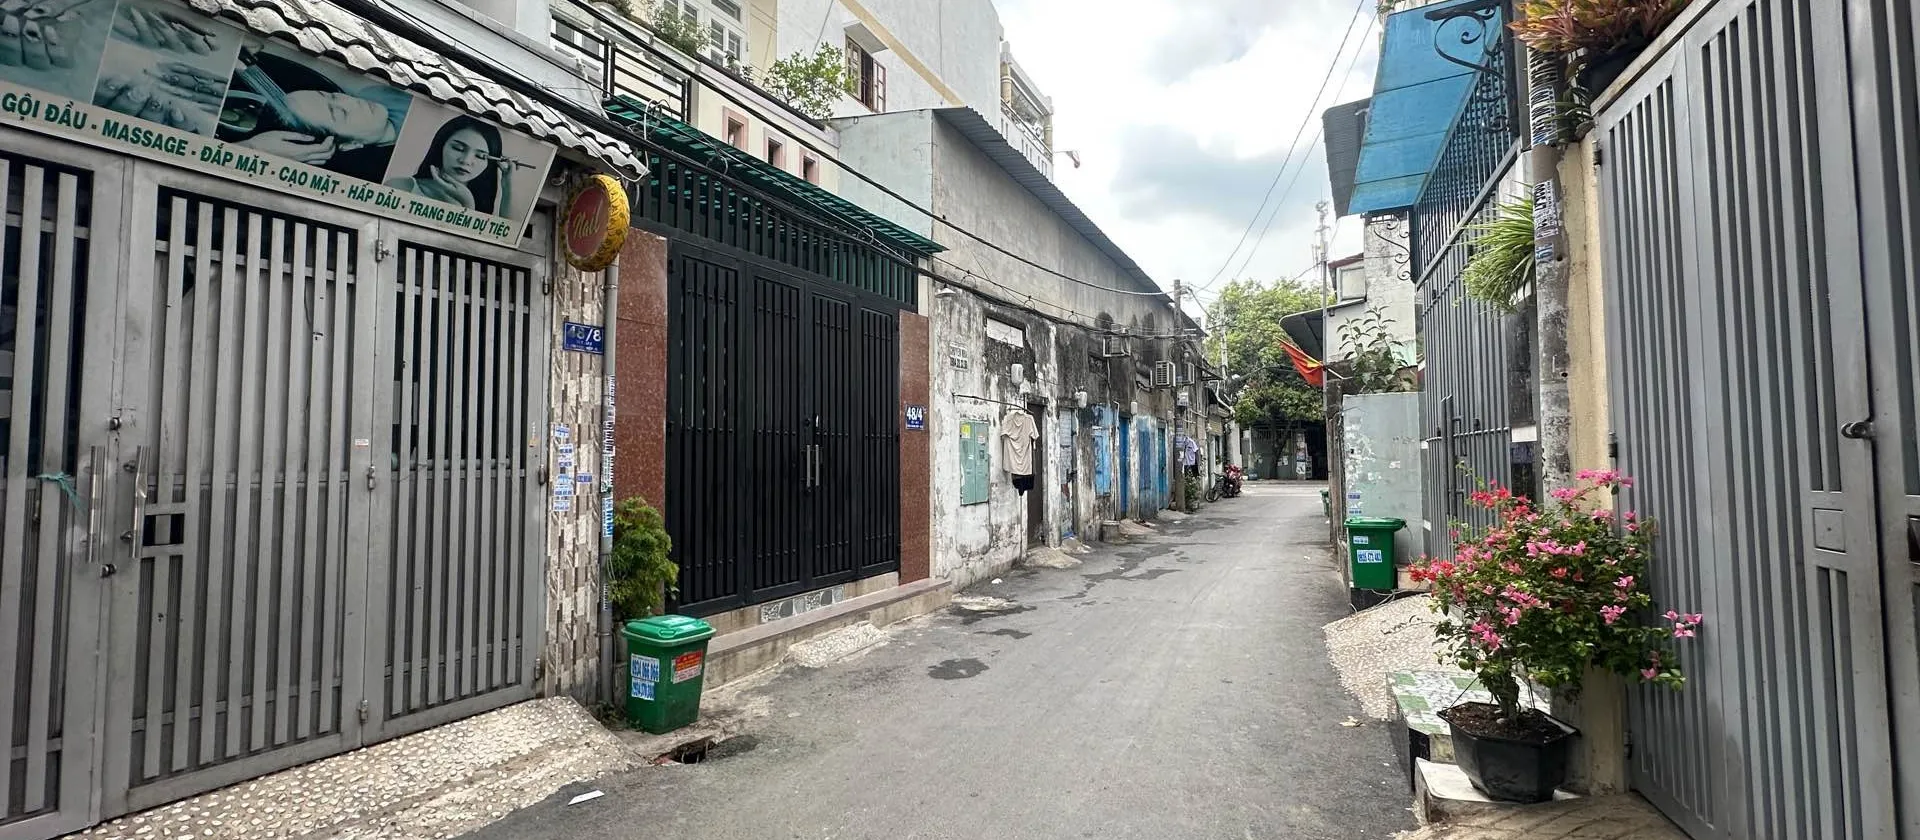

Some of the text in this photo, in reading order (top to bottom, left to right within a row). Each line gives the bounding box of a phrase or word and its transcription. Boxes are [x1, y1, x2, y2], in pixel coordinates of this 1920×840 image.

[1, 92, 40, 121] GỘI
[44, 101, 88, 129] ĐẦU
[102, 119, 188, 156] MASSAGE
[200, 143, 233, 167] ĐẮP
[235, 154, 270, 177] MẶT
[279, 166, 308, 188] CẠO
[309, 174, 340, 196] MẶT
[347, 182, 374, 203] HẤP
[408, 200, 444, 221] TRANG
[472, 217, 489, 235] DỰ
[489, 221, 511, 239] TIỆC
[906, 406, 923, 421] 48/4
